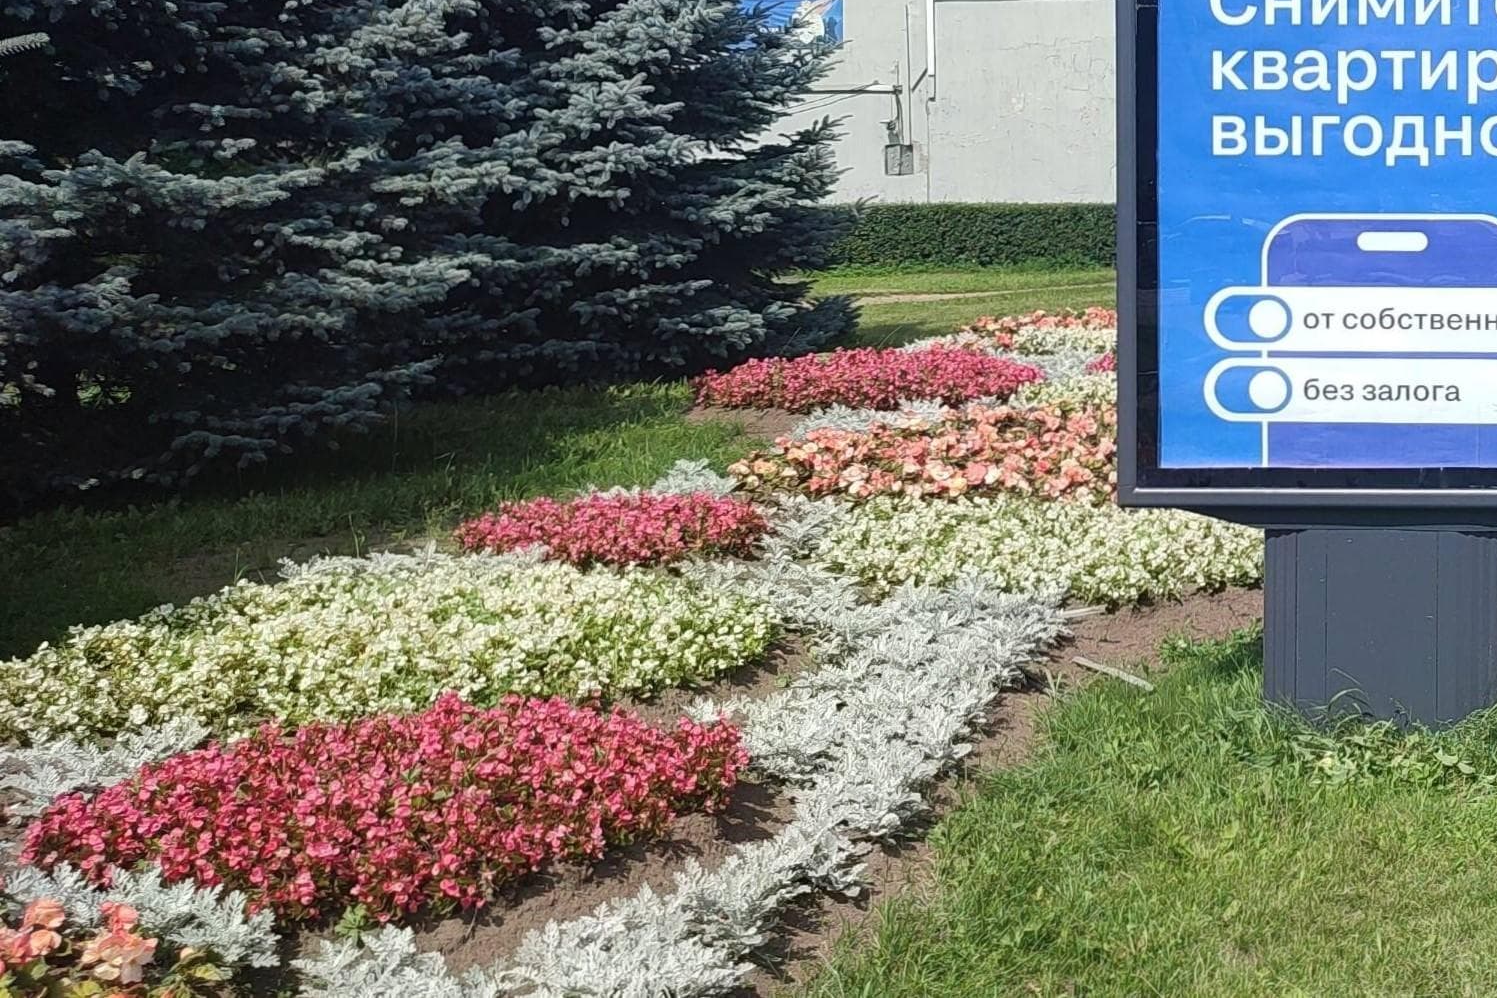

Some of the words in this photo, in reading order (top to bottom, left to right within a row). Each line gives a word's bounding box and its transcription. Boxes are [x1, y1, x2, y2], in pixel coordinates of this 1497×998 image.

[1302, 309, 1333, 330] от
[1303, 378, 1354, 402] без
[1361, 382, 1462, 403] залога
